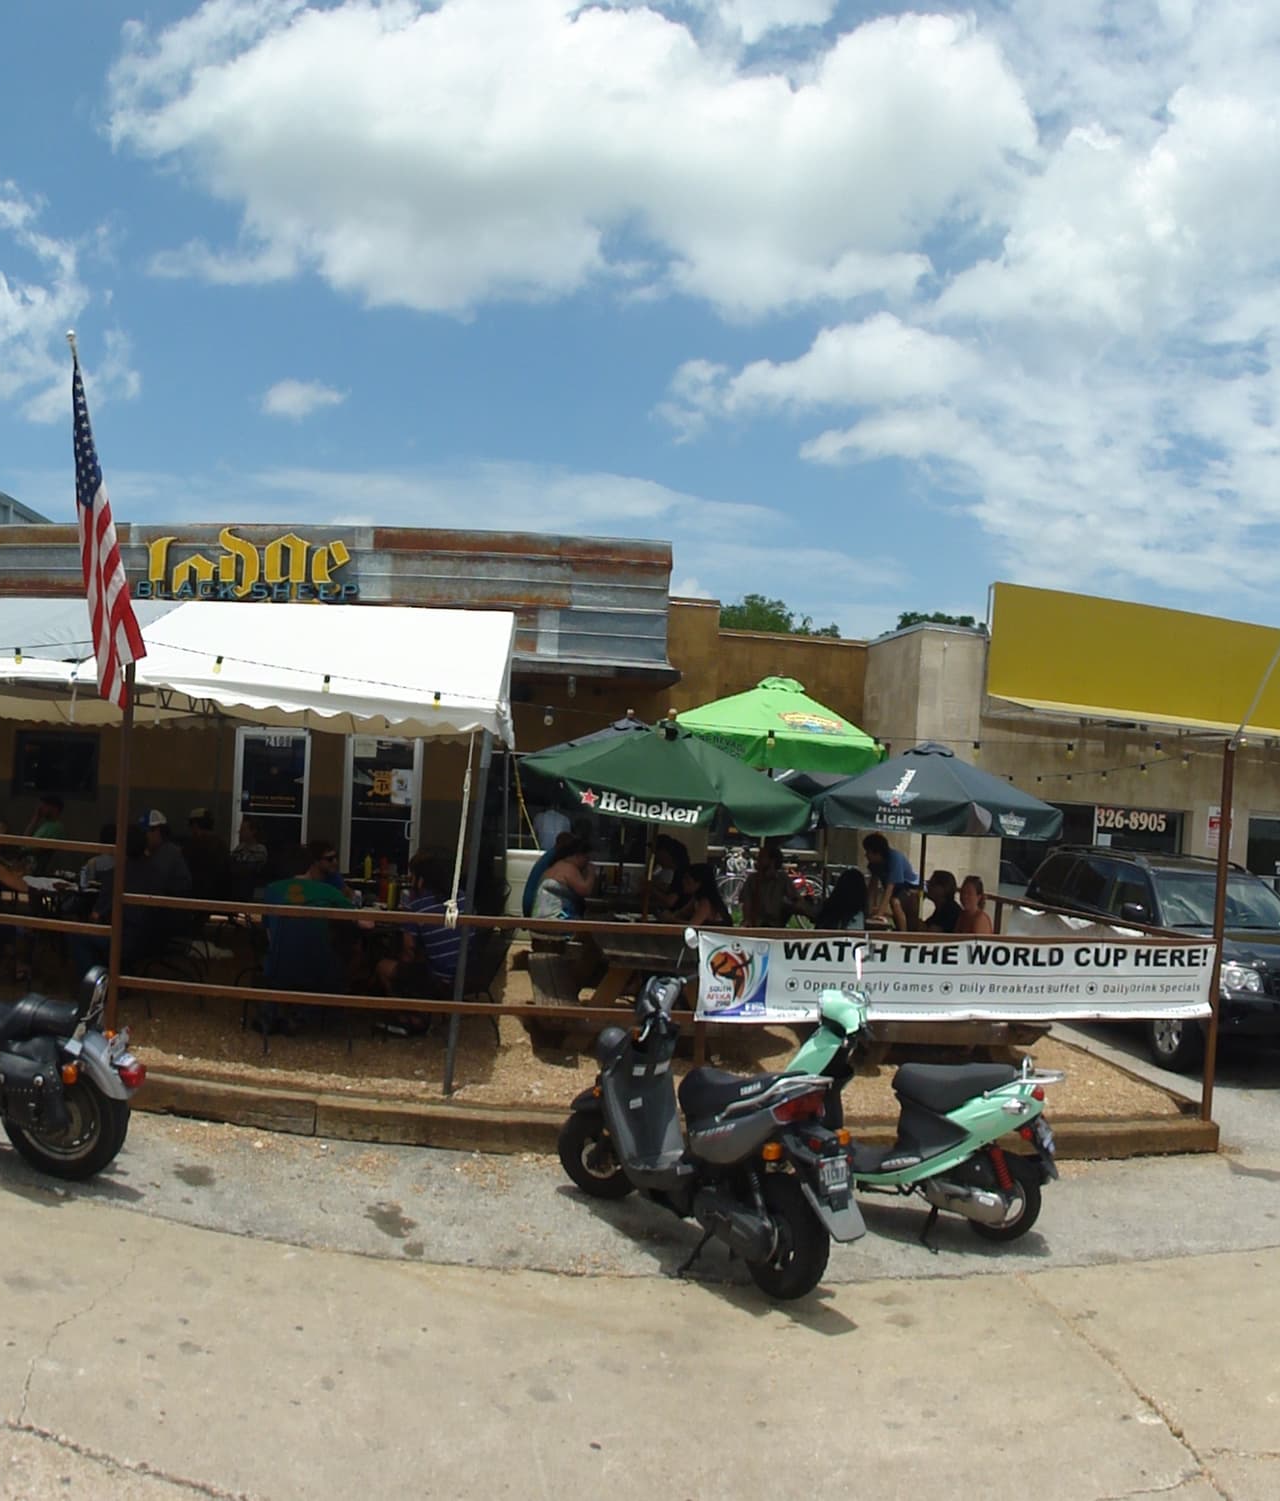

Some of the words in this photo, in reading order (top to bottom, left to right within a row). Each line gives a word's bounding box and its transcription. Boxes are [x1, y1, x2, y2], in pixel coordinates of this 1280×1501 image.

[136, 580, 237, 599] BLACK
[251, 582, 361, 600] SHEEP
[599, 791, 703, 824] Heineken
[875, 813, 914, 825] LIGHT
[1097, 808, 1167, 832] 326-8905
[784, 941, 889, 963] WATCH
[900, 944, 959, 965] THE
[967, 944, 1064, 967] WORLD
[1074, 947, 1127, 968] CUP
[1133, 947, 1208, 968] HERE!
[803, 980, 837, 992] Open
[893, 981, 934, 993] Games
[989, 983, 1045, 994] Breakfast
[1103, 984, 1129, 995] Daily
[1130, 983, 1157, 993] Drink
[1160, 982, 1200, 994] Specials
